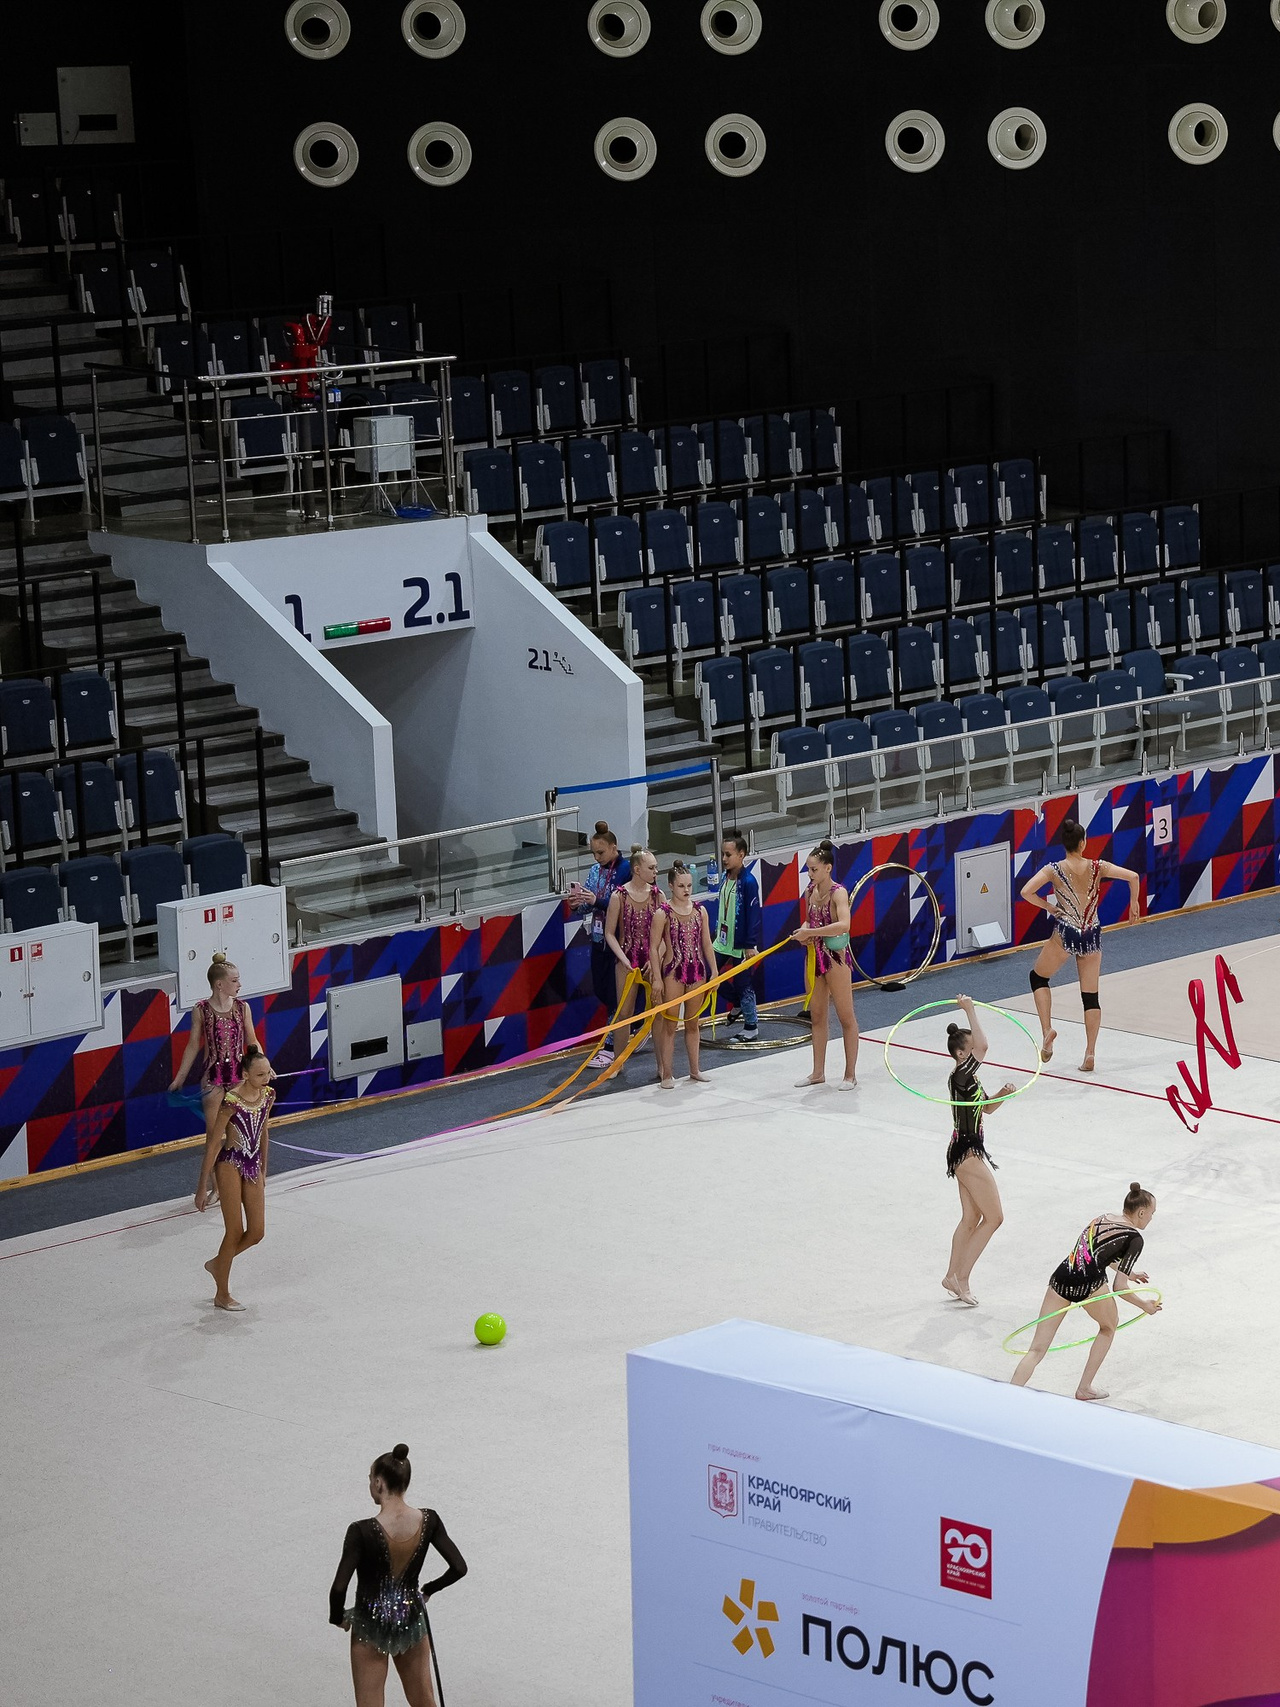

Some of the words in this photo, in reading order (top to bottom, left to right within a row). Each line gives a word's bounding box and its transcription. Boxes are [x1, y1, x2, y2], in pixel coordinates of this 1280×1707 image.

[403, 572, 471, 629] 2.1
[528, 647, 552, 672] 2.1
[1159, 818, 1168, 840] 3
[748, 1474, 852, 1514] КРАСНОЯРСКИЙ
[748, 1491, 781, 1513] КРАЙ
[748, 1515, 827, 1547] ПРАВИТЕЛЬСТВО
[802, 1613, 995, 1707] ПОЛЮС
